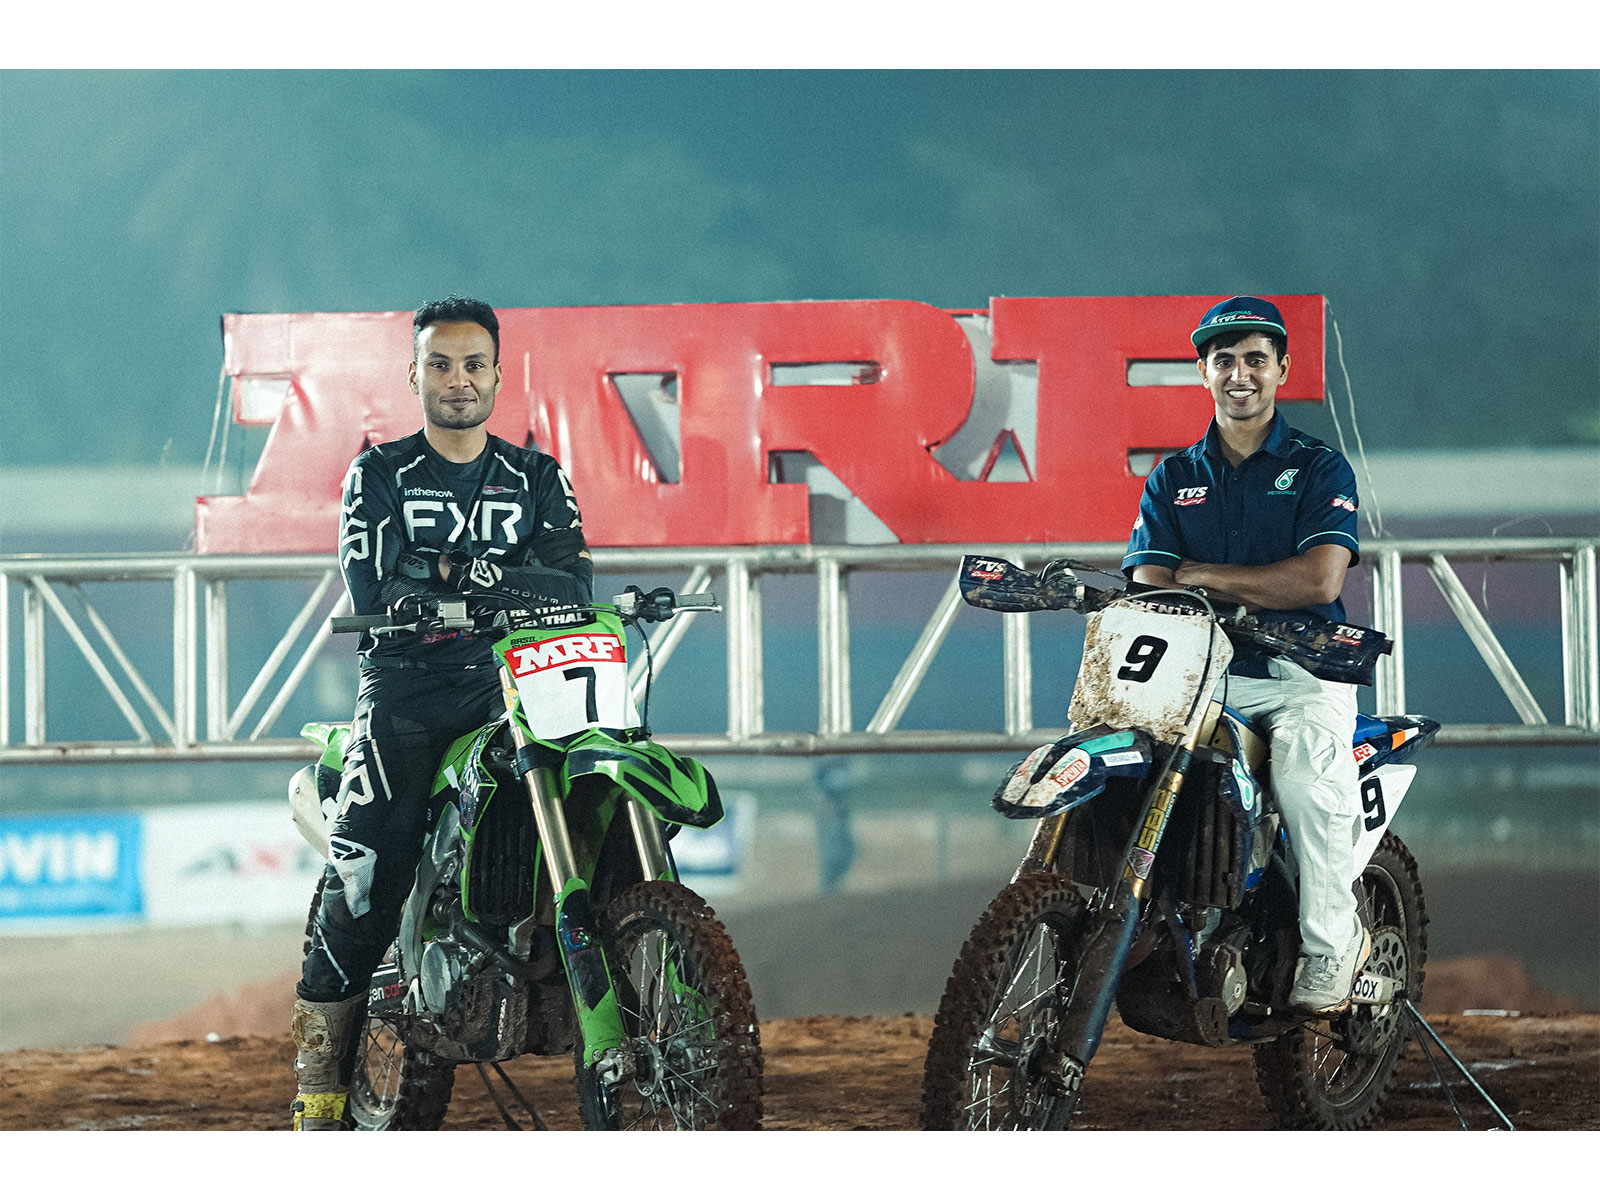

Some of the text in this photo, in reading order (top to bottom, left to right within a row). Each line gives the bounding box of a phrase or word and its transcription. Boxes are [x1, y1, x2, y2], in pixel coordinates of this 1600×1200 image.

[1177, 486, 1209, 500] TVS
[403, 500, 523, 545] FXR
[975, 559, 1008, 574] TVS
[1335, 624, 1366, 640] TVS
[513, 636, 619, 674] MRF
[1117, 634, 1169, 684] 9
[562, 666, 600, 724] 7
[1352, 744, 1372, 763] RF
[1360, 775, 1387, 833] 9
